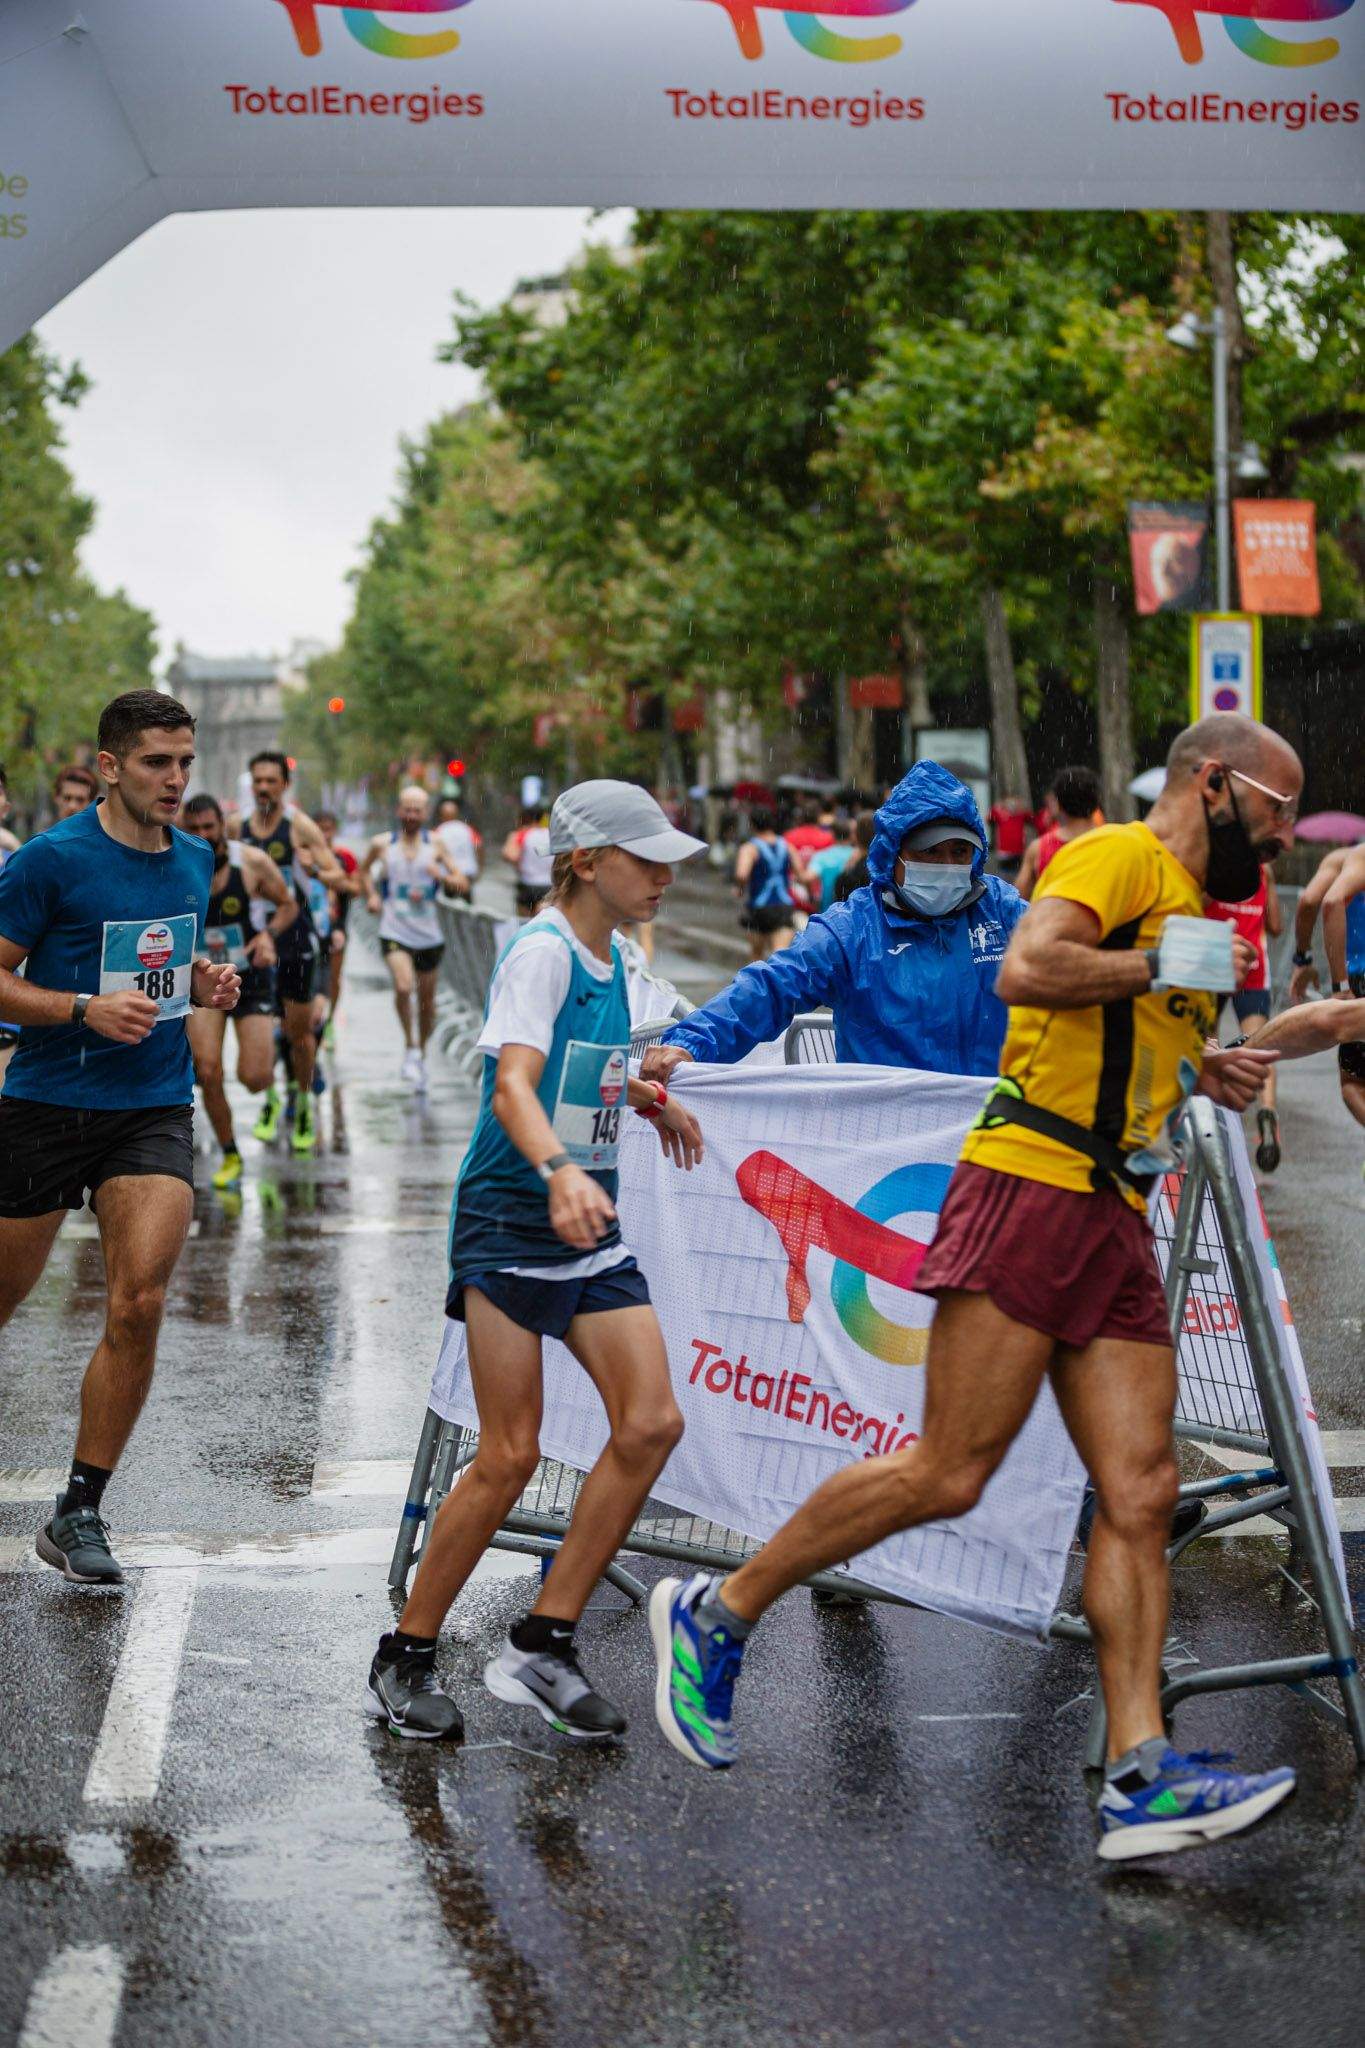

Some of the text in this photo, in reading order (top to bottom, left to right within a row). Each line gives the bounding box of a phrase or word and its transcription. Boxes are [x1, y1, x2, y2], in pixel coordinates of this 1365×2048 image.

[223, 85, 484, 124] TotalEnergies
[664, 88, 925, 128] TotalEnergies
[1105, 90, 1361, 131] TotalEnergies
[0, 169, 29, 198] e
[973, 953, 1006, 965] OLUNTAR
[133, 968, 175, 1000] 188
[591, 1109, 621, 1144] 143
